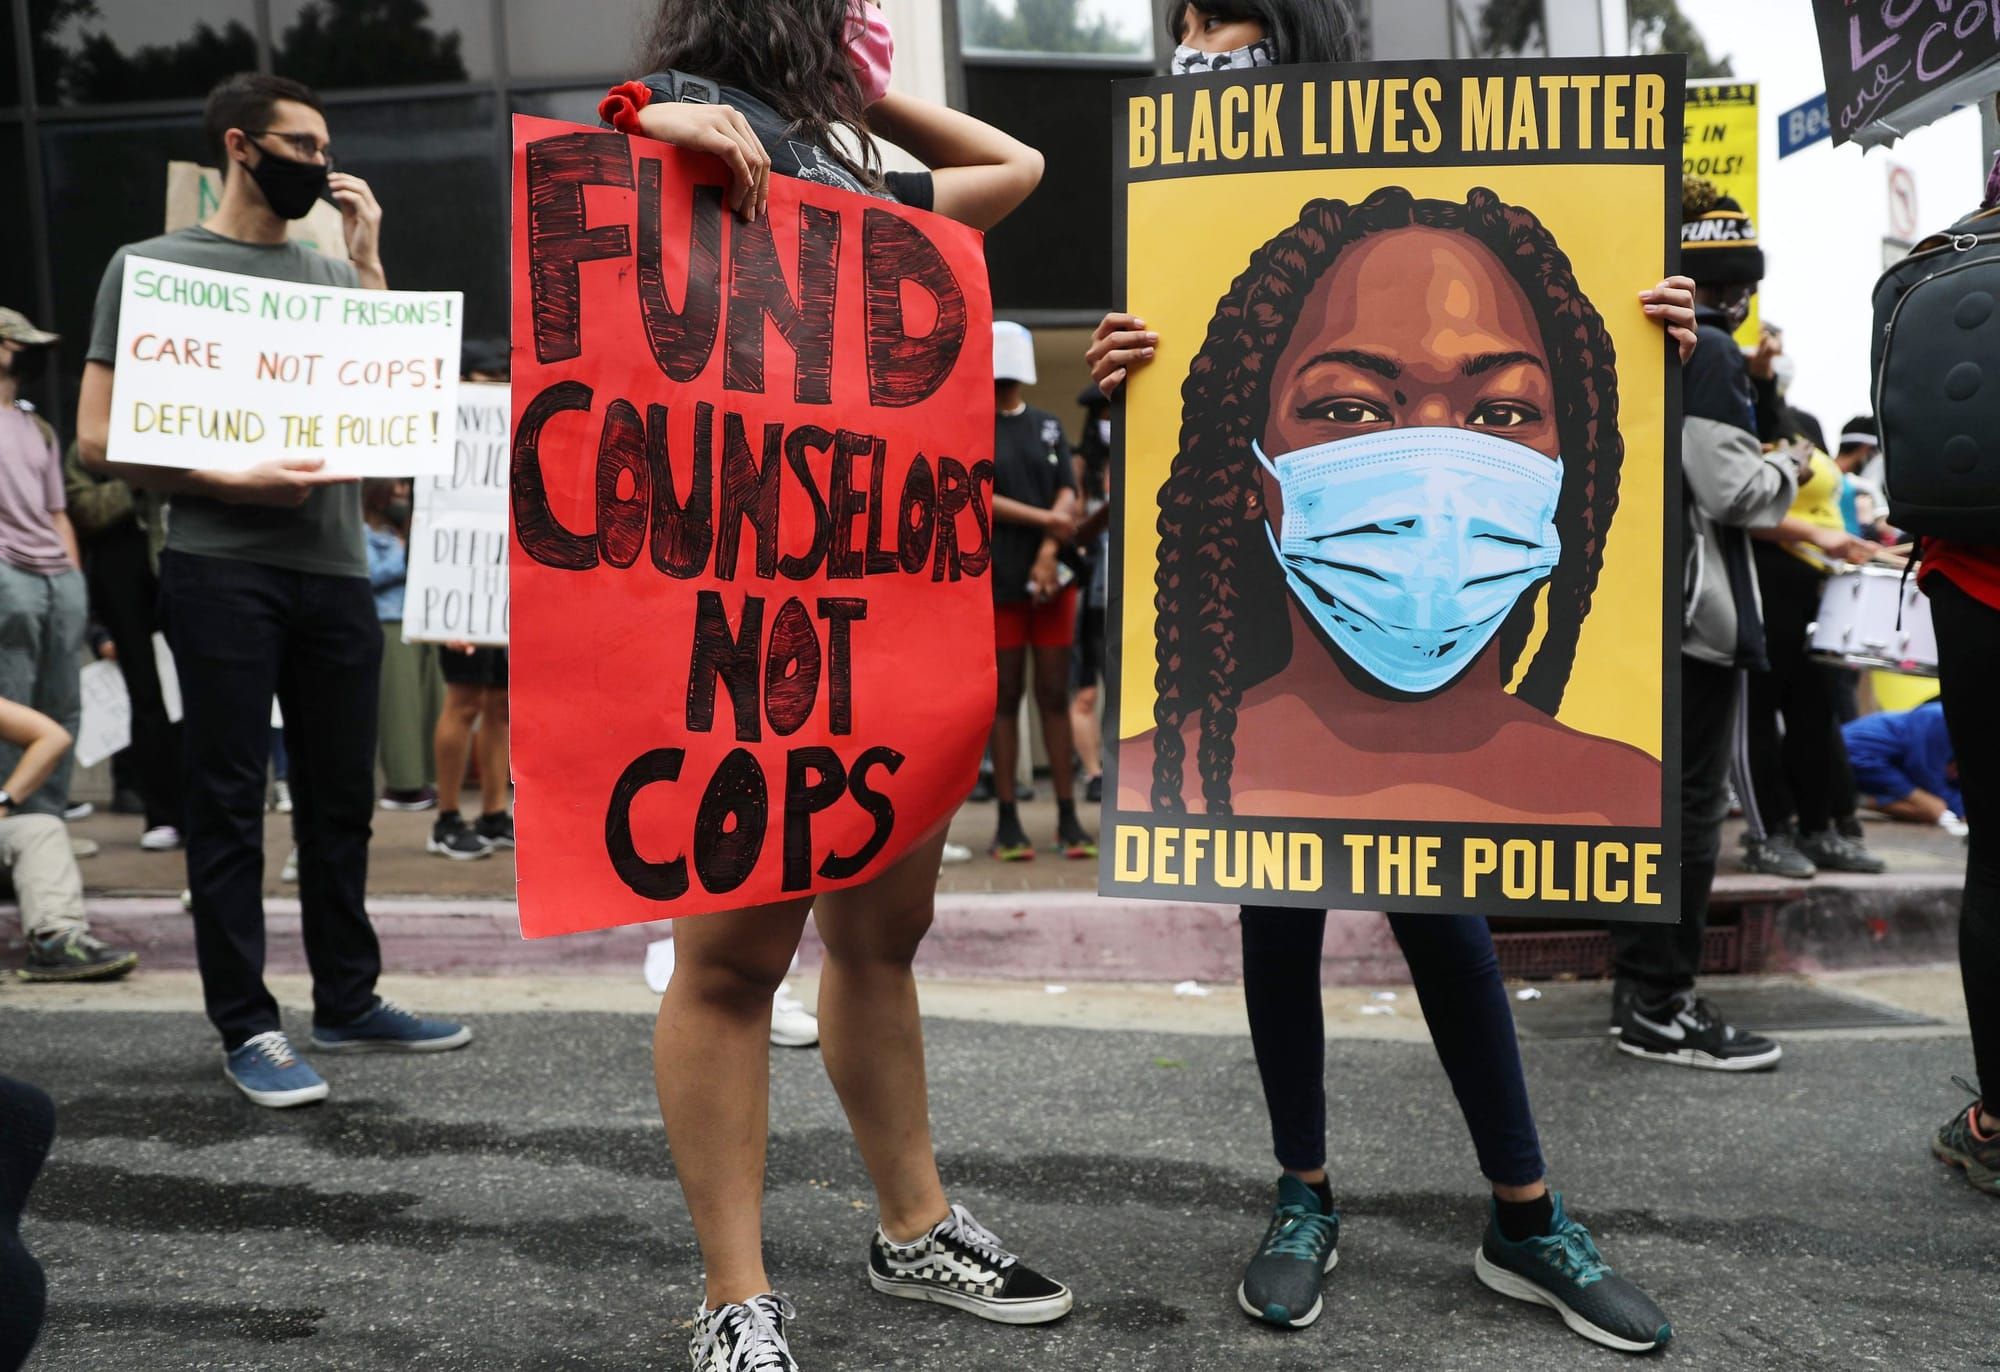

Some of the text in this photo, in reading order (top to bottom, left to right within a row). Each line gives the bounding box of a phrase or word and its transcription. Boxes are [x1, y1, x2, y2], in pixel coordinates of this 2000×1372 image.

[1129, 73, 1666, 168] BLACK LIVES MATTER
[133, 269, 453, 327] SCHOOLS NOT PRISONS!
[526, 131, 967, 408] FUND
[131, 333, 445, 390] CARE NOT COPS!
[133, 401, 265, 443] DEFUND
[280, 414, 323, 448] THE
[512, 380, 995, 582] COUNSELORS
[433, 528, 508, 566] DEFU
[686, 590, 868, 743] NOT
[605, 745, 906, 901] COPS
[1114, 824, 1662, 905] DEFUND THE POLICE
